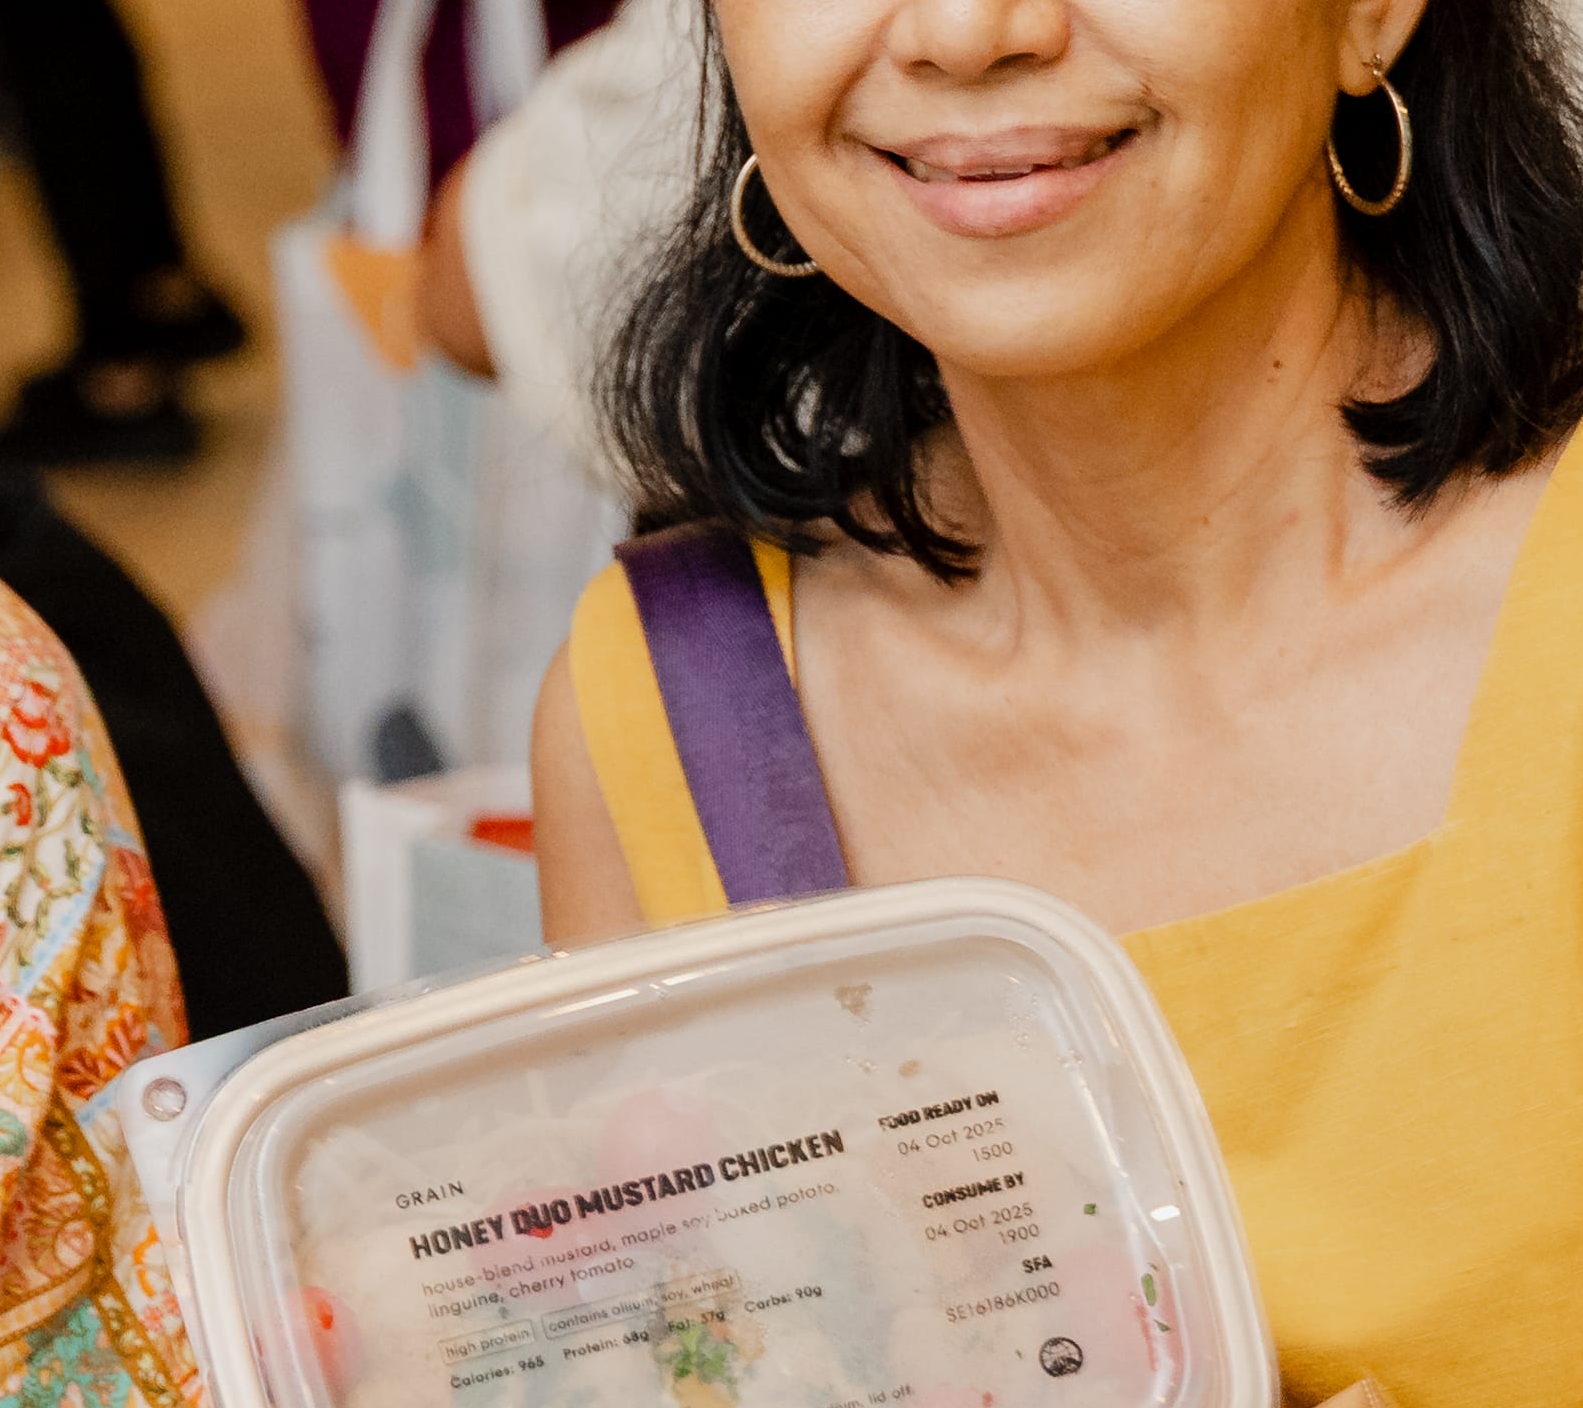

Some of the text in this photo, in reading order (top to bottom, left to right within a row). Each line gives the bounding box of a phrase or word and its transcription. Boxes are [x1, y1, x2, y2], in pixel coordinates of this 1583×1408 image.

[878, 1090, 1000, 1131] FOOD READY ON
[897, 1117, 1006, 1157] 04 Oct 2025
[971, 1140, 1014, 1163] 1500
[395, 1180, 465, 1210] GRAIN
[409, 1128, 846, 1260] HONEY DUO MUSTARD CHICKEN
[921, 1170, 1026, 1209] CONSUME BY
[422, 1256, 534, 1297] house-blend
[540, 1239, 617, 1268] mustard,
[621, 1218, 678, 1248] maple
[776, 1181, 842, 1209] potato,
[924, 1201, 1034, 1242] 04 Oct 2025
[998, 1222, 1041, 1246] 1900
[1021, 1254, 1053, 1274] SFA
[427, 1255, 635, 1319] linguine, cherry tomato
[548, 1307, 609, 1333] contains
[691, 1274, 735, 1295] wheat
[744, 1294, 793, 1314] Carbs:
[445, 1327, 531, 1360] high protein
[563, 1336, 619, 1360] Protein:
[449, 1355, 546, 1390] Calories: 965
[867, 1389, 887, 1406] lid
